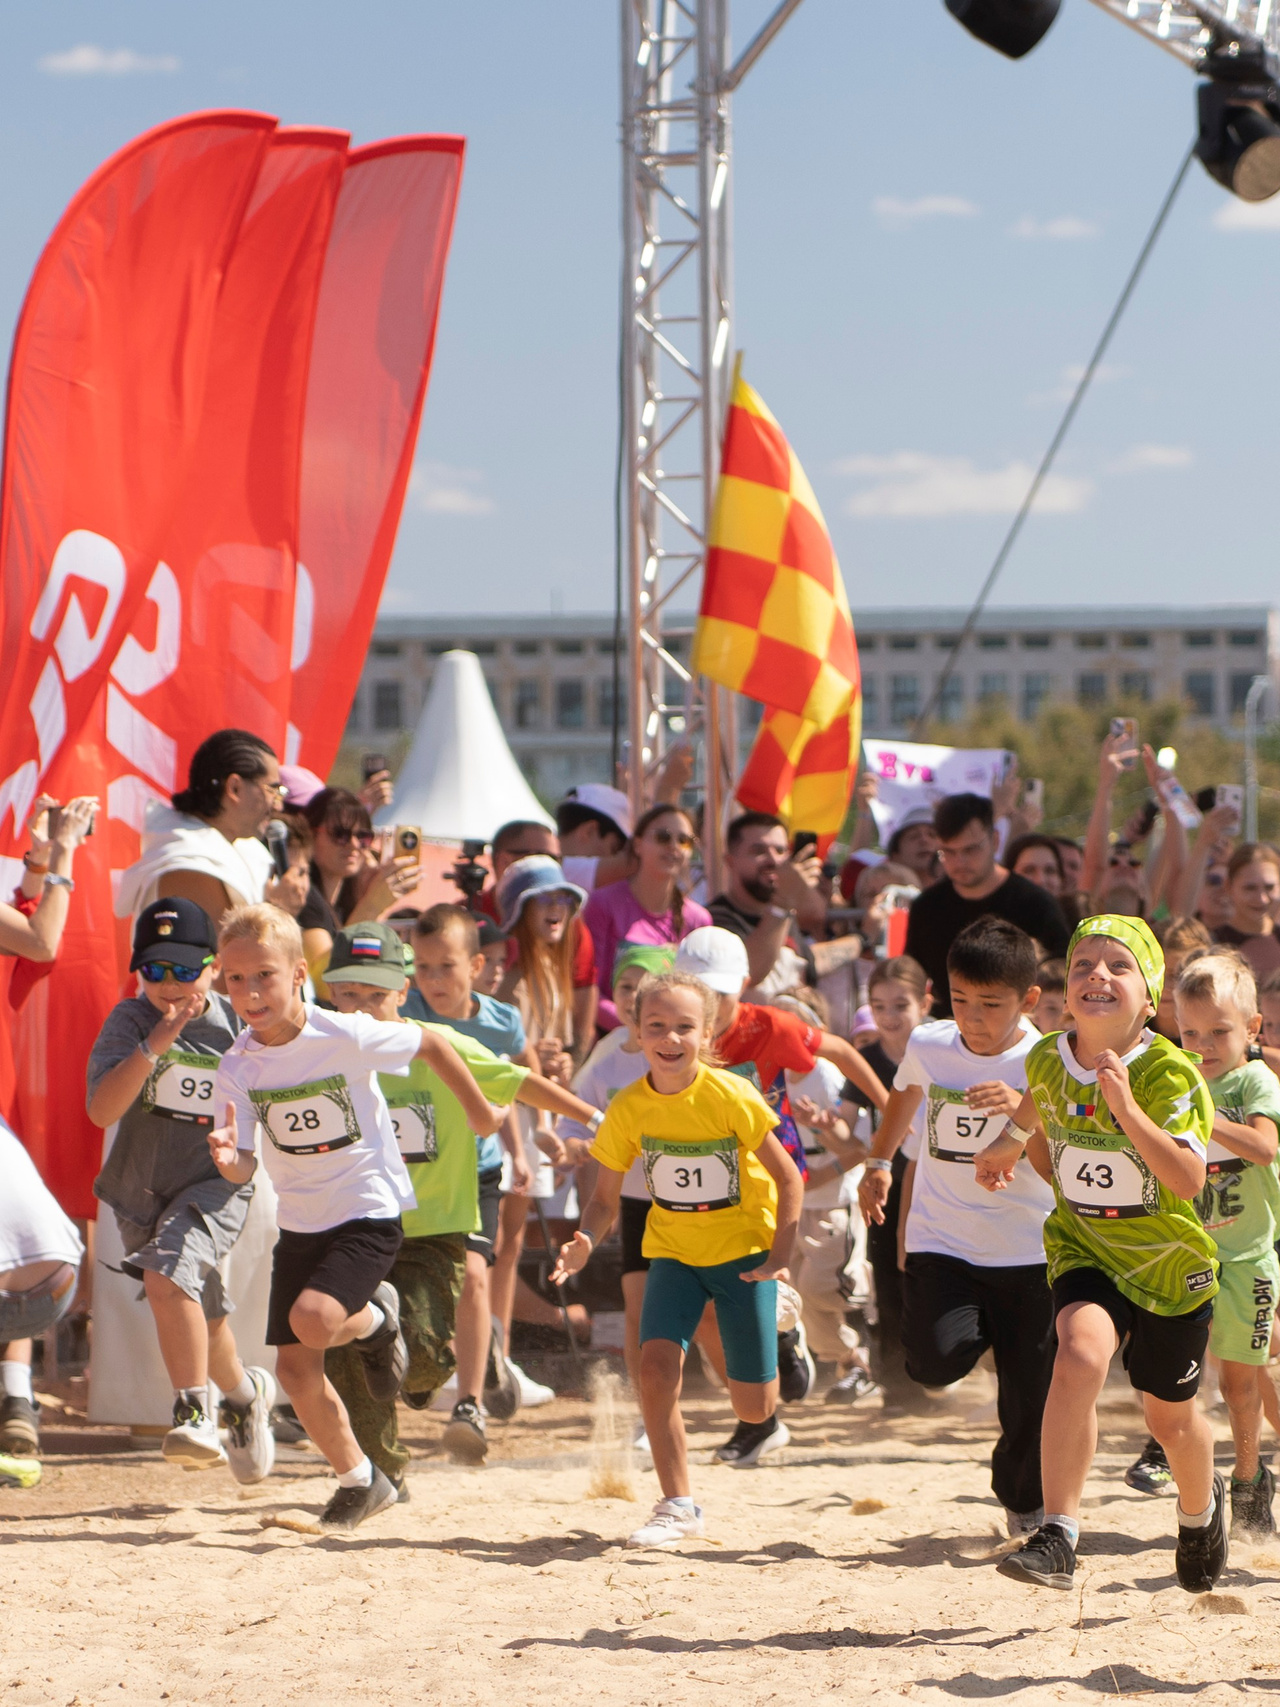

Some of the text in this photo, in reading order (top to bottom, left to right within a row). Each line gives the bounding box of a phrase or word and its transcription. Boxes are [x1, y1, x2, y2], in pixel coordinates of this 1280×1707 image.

[1089, 919, 1113, 932] 12
[179, 1054, 216, 1067] РОСТОК
[180, 1077, 214, 1100] 93
[270, 1087, 308, 1100] РОСТОК
[947, 1091, 966, 1101] РОС
[284, 1109, 321, 1132] 28
[956, 1116, 989, 1138] 57
[663, 1143, 701, 1154] РОСТОК
[1068, 1132, 1107, 1147] РОСТОК
[674, 1167, 703, 1188] 31
[1076, 1162, 1114, 1189] 43
[1251, 1276, 1273, 1350] SUPER DAY
